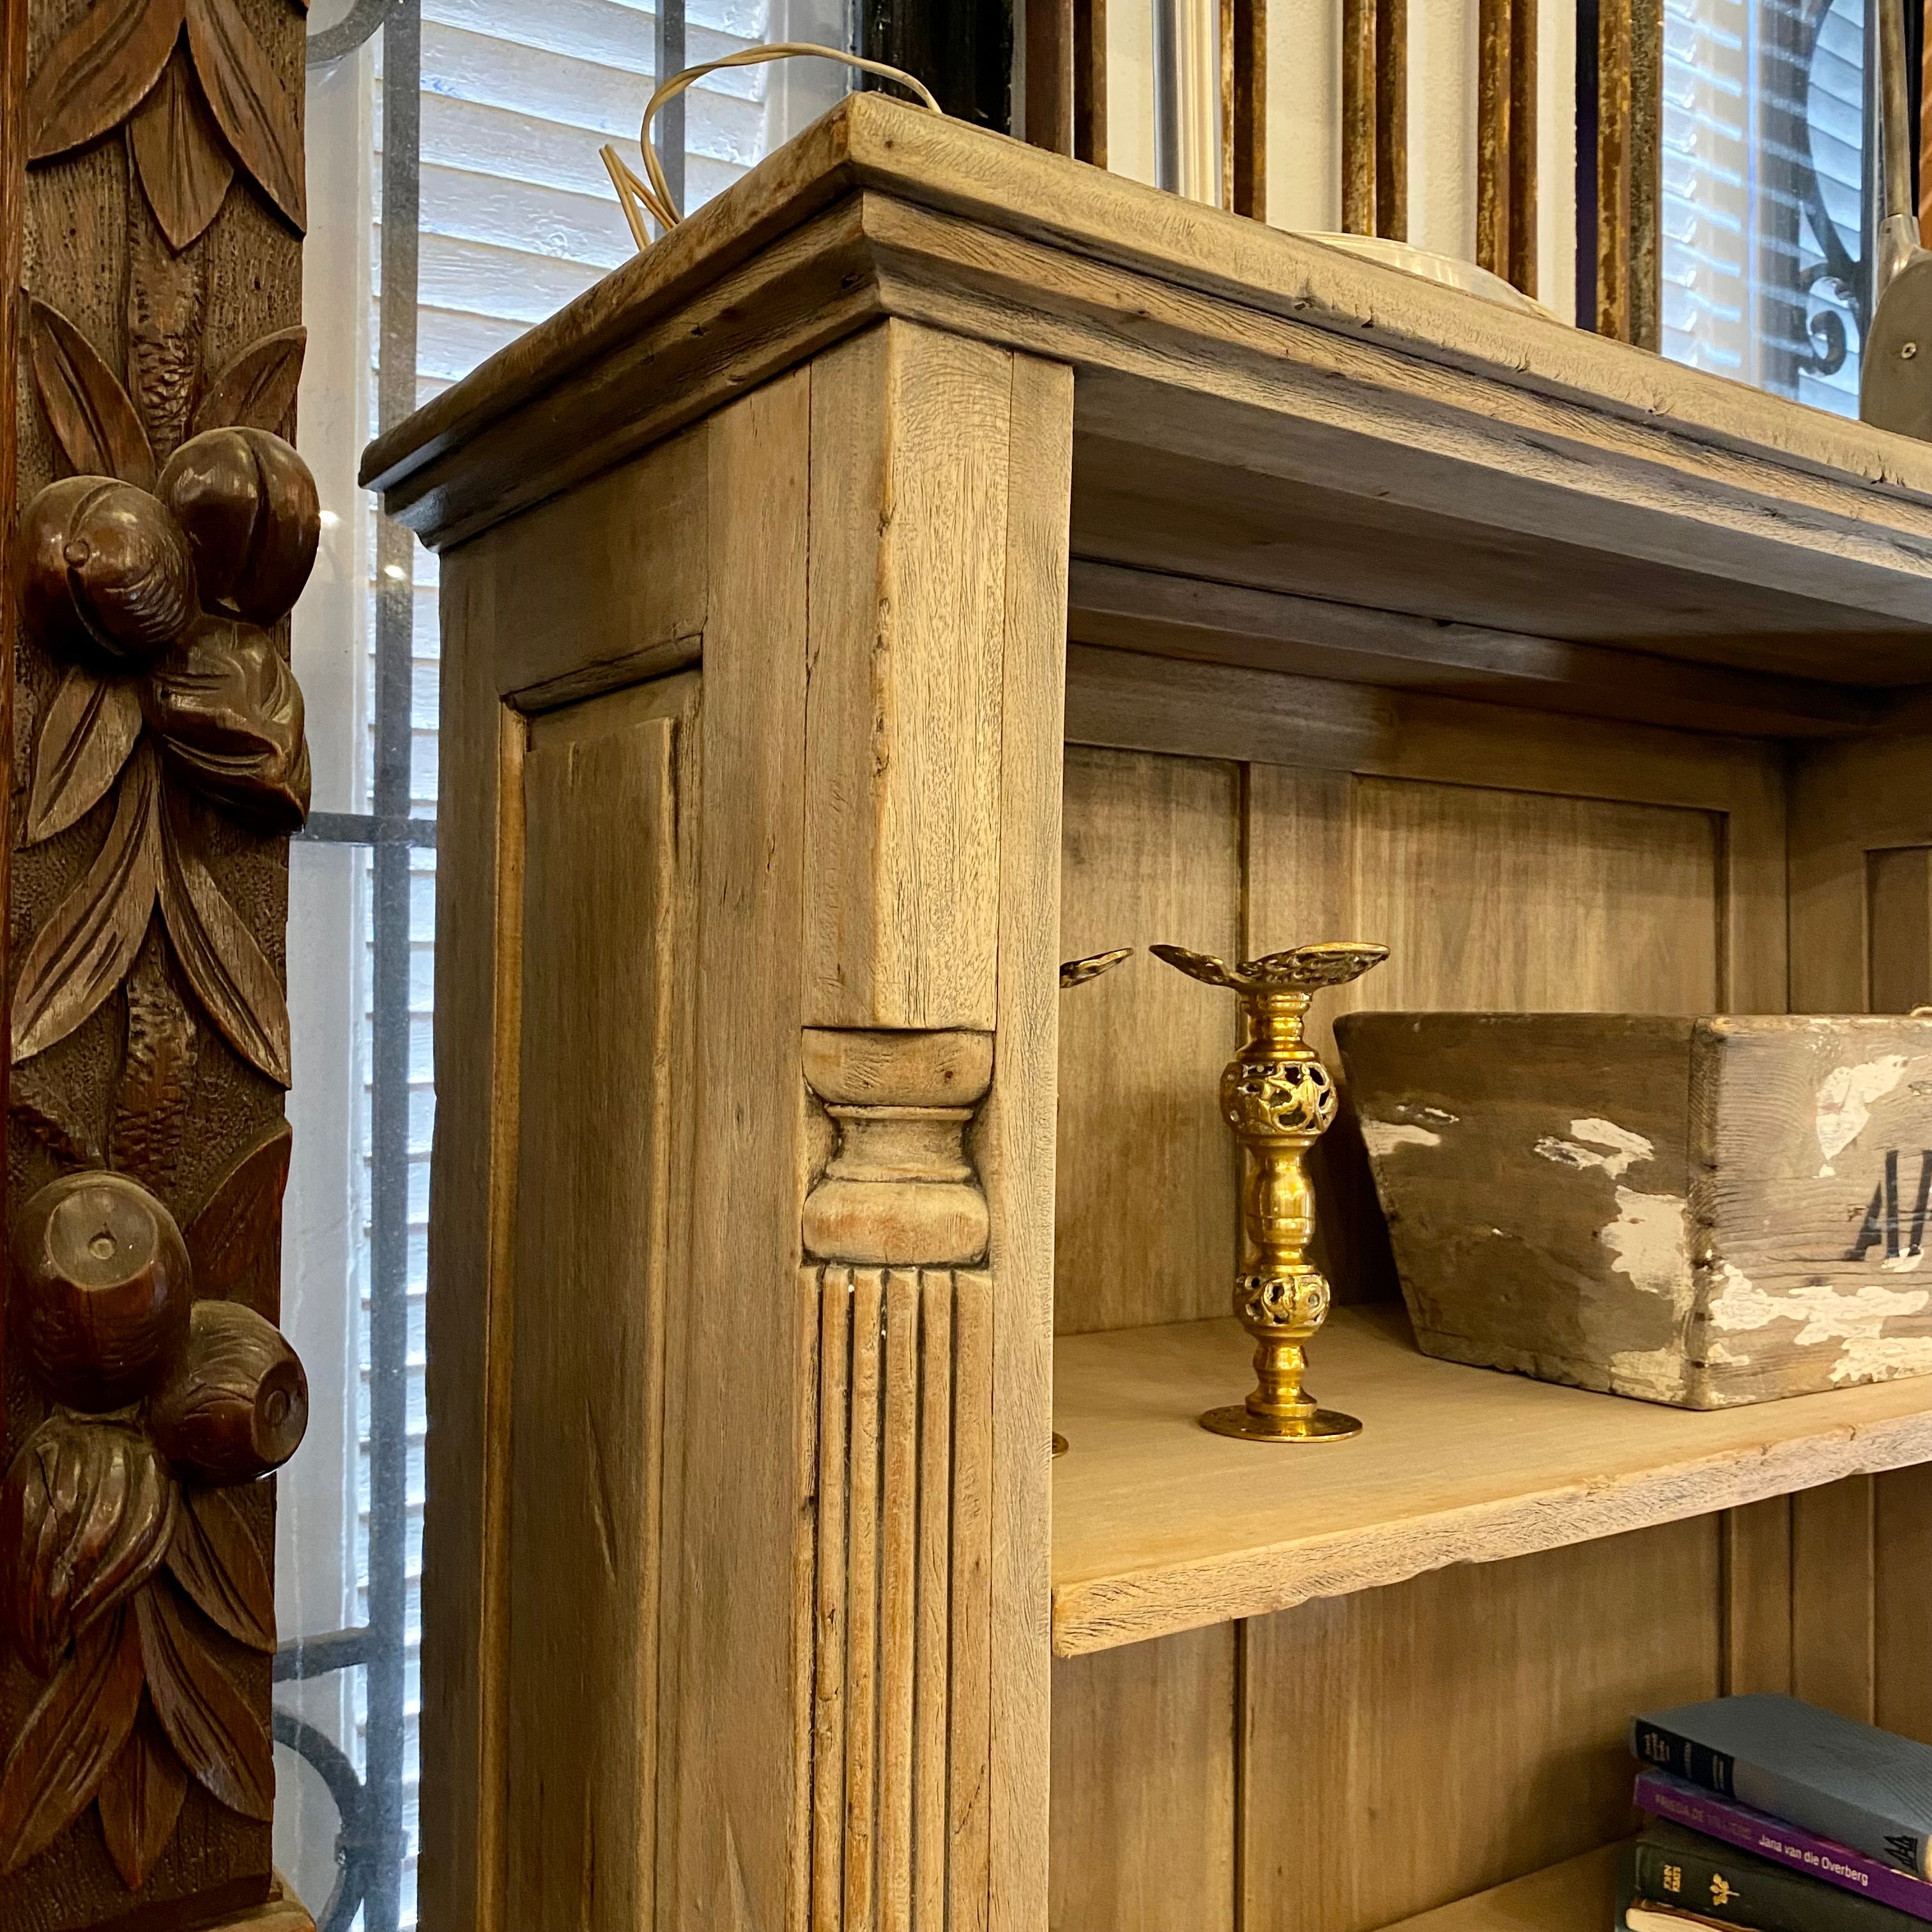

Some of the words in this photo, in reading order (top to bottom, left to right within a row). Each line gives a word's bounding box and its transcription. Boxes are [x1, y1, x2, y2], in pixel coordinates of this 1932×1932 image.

[1759, 1835, 1782, 1852] Jana
[1784, 1844, 1802, 1859] van
[1804, 1851, 1820, 1866] die
[1821, 1857, 1868, 1887] Overberg
